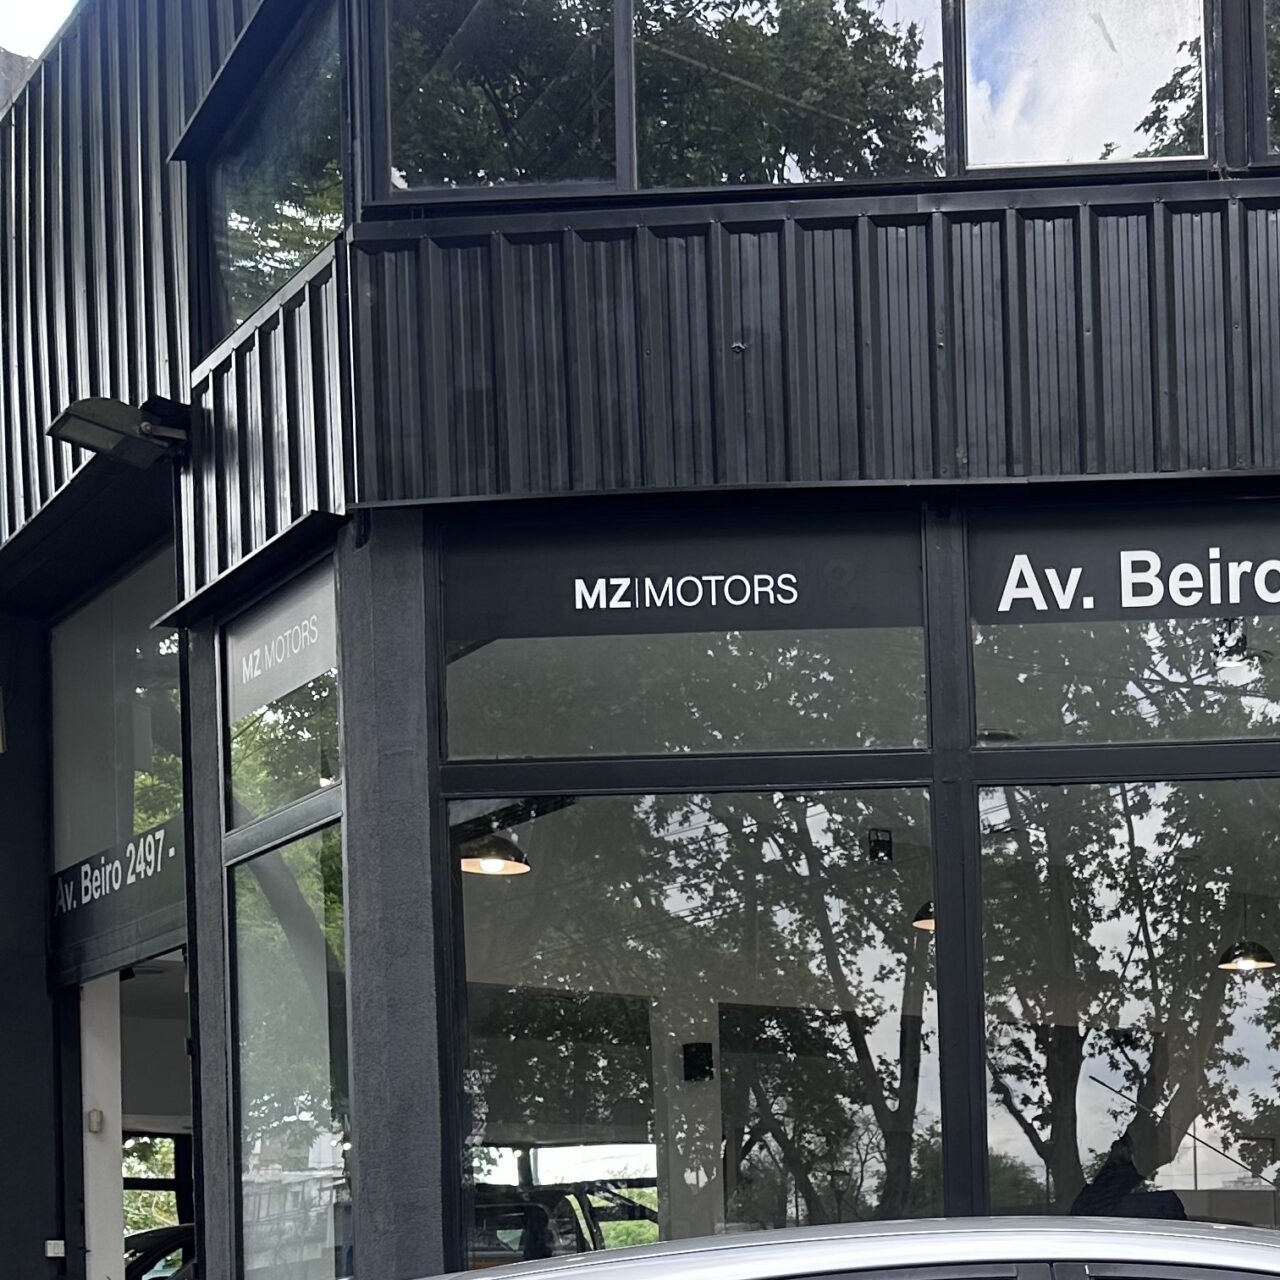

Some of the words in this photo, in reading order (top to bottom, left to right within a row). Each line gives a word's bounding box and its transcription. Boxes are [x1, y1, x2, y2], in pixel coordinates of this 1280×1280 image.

[997, 553, 1096, 612] Av.
[54, 876, 77, 918] Av.
[80, 856, 122, 905] Beiro
[126, 828, 165, 885] 2497
